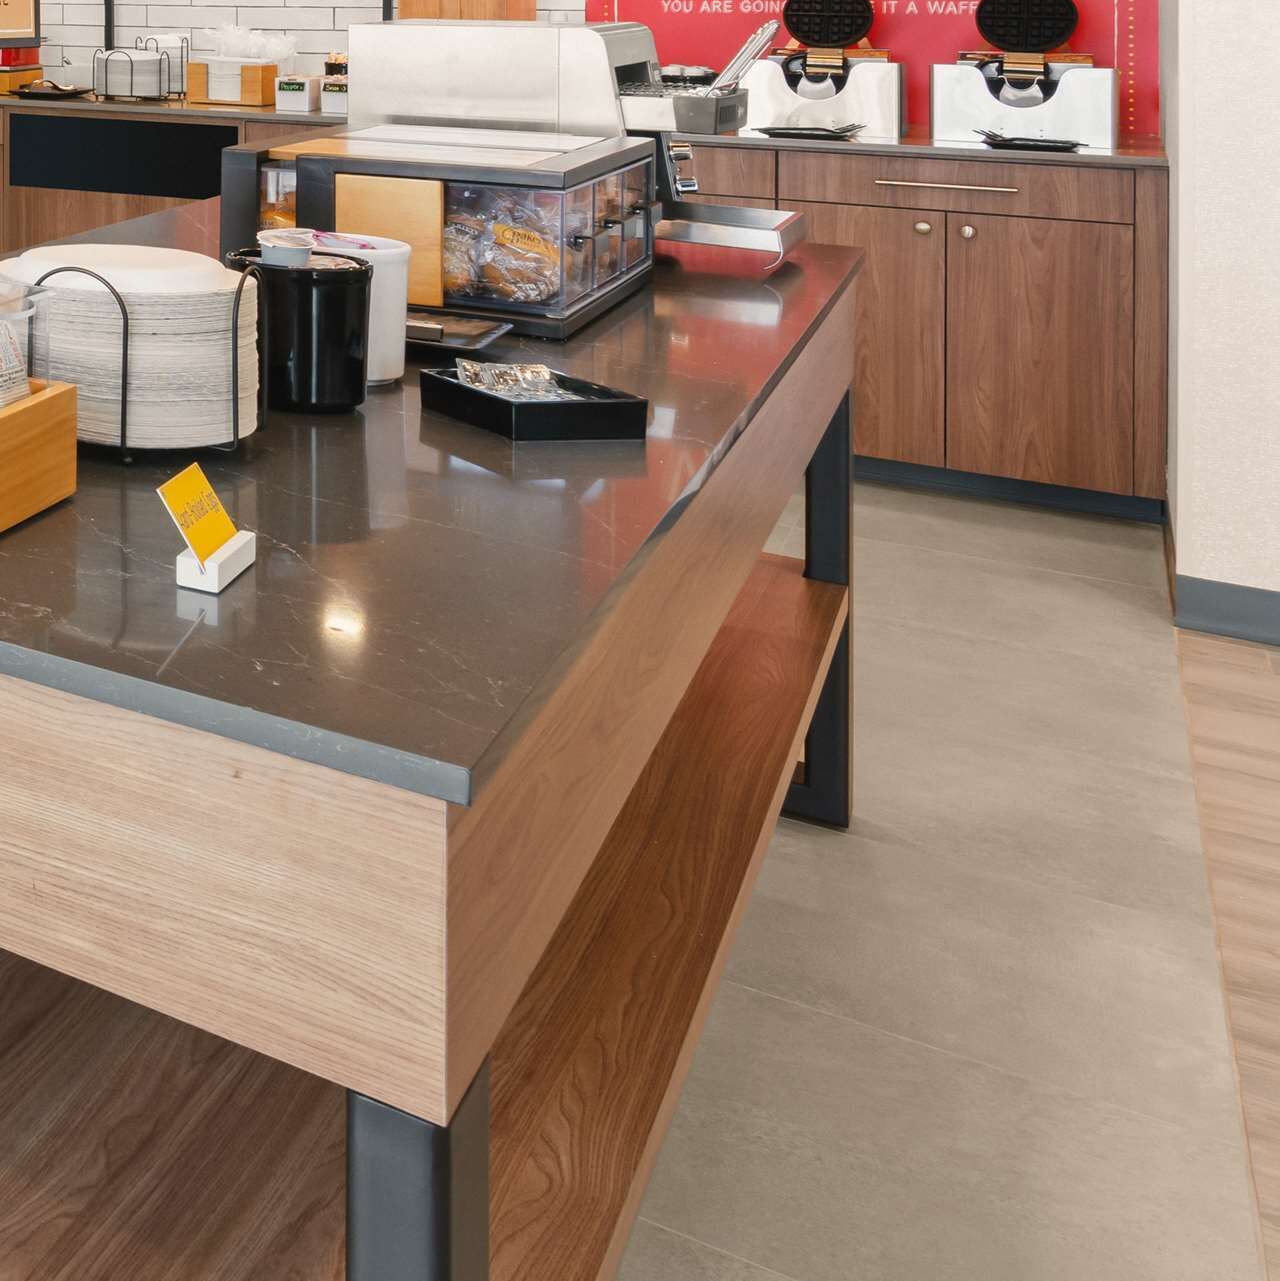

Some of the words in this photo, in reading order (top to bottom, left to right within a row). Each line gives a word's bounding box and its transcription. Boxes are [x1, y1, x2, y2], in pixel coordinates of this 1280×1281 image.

[661, 0, 693, 13] YOU
[699, 0, 733, 13] ARE
[881, 1, 898, 14] IT
[905, 1, 919, 14] A
[927, 1, 979, 15] WAFF
